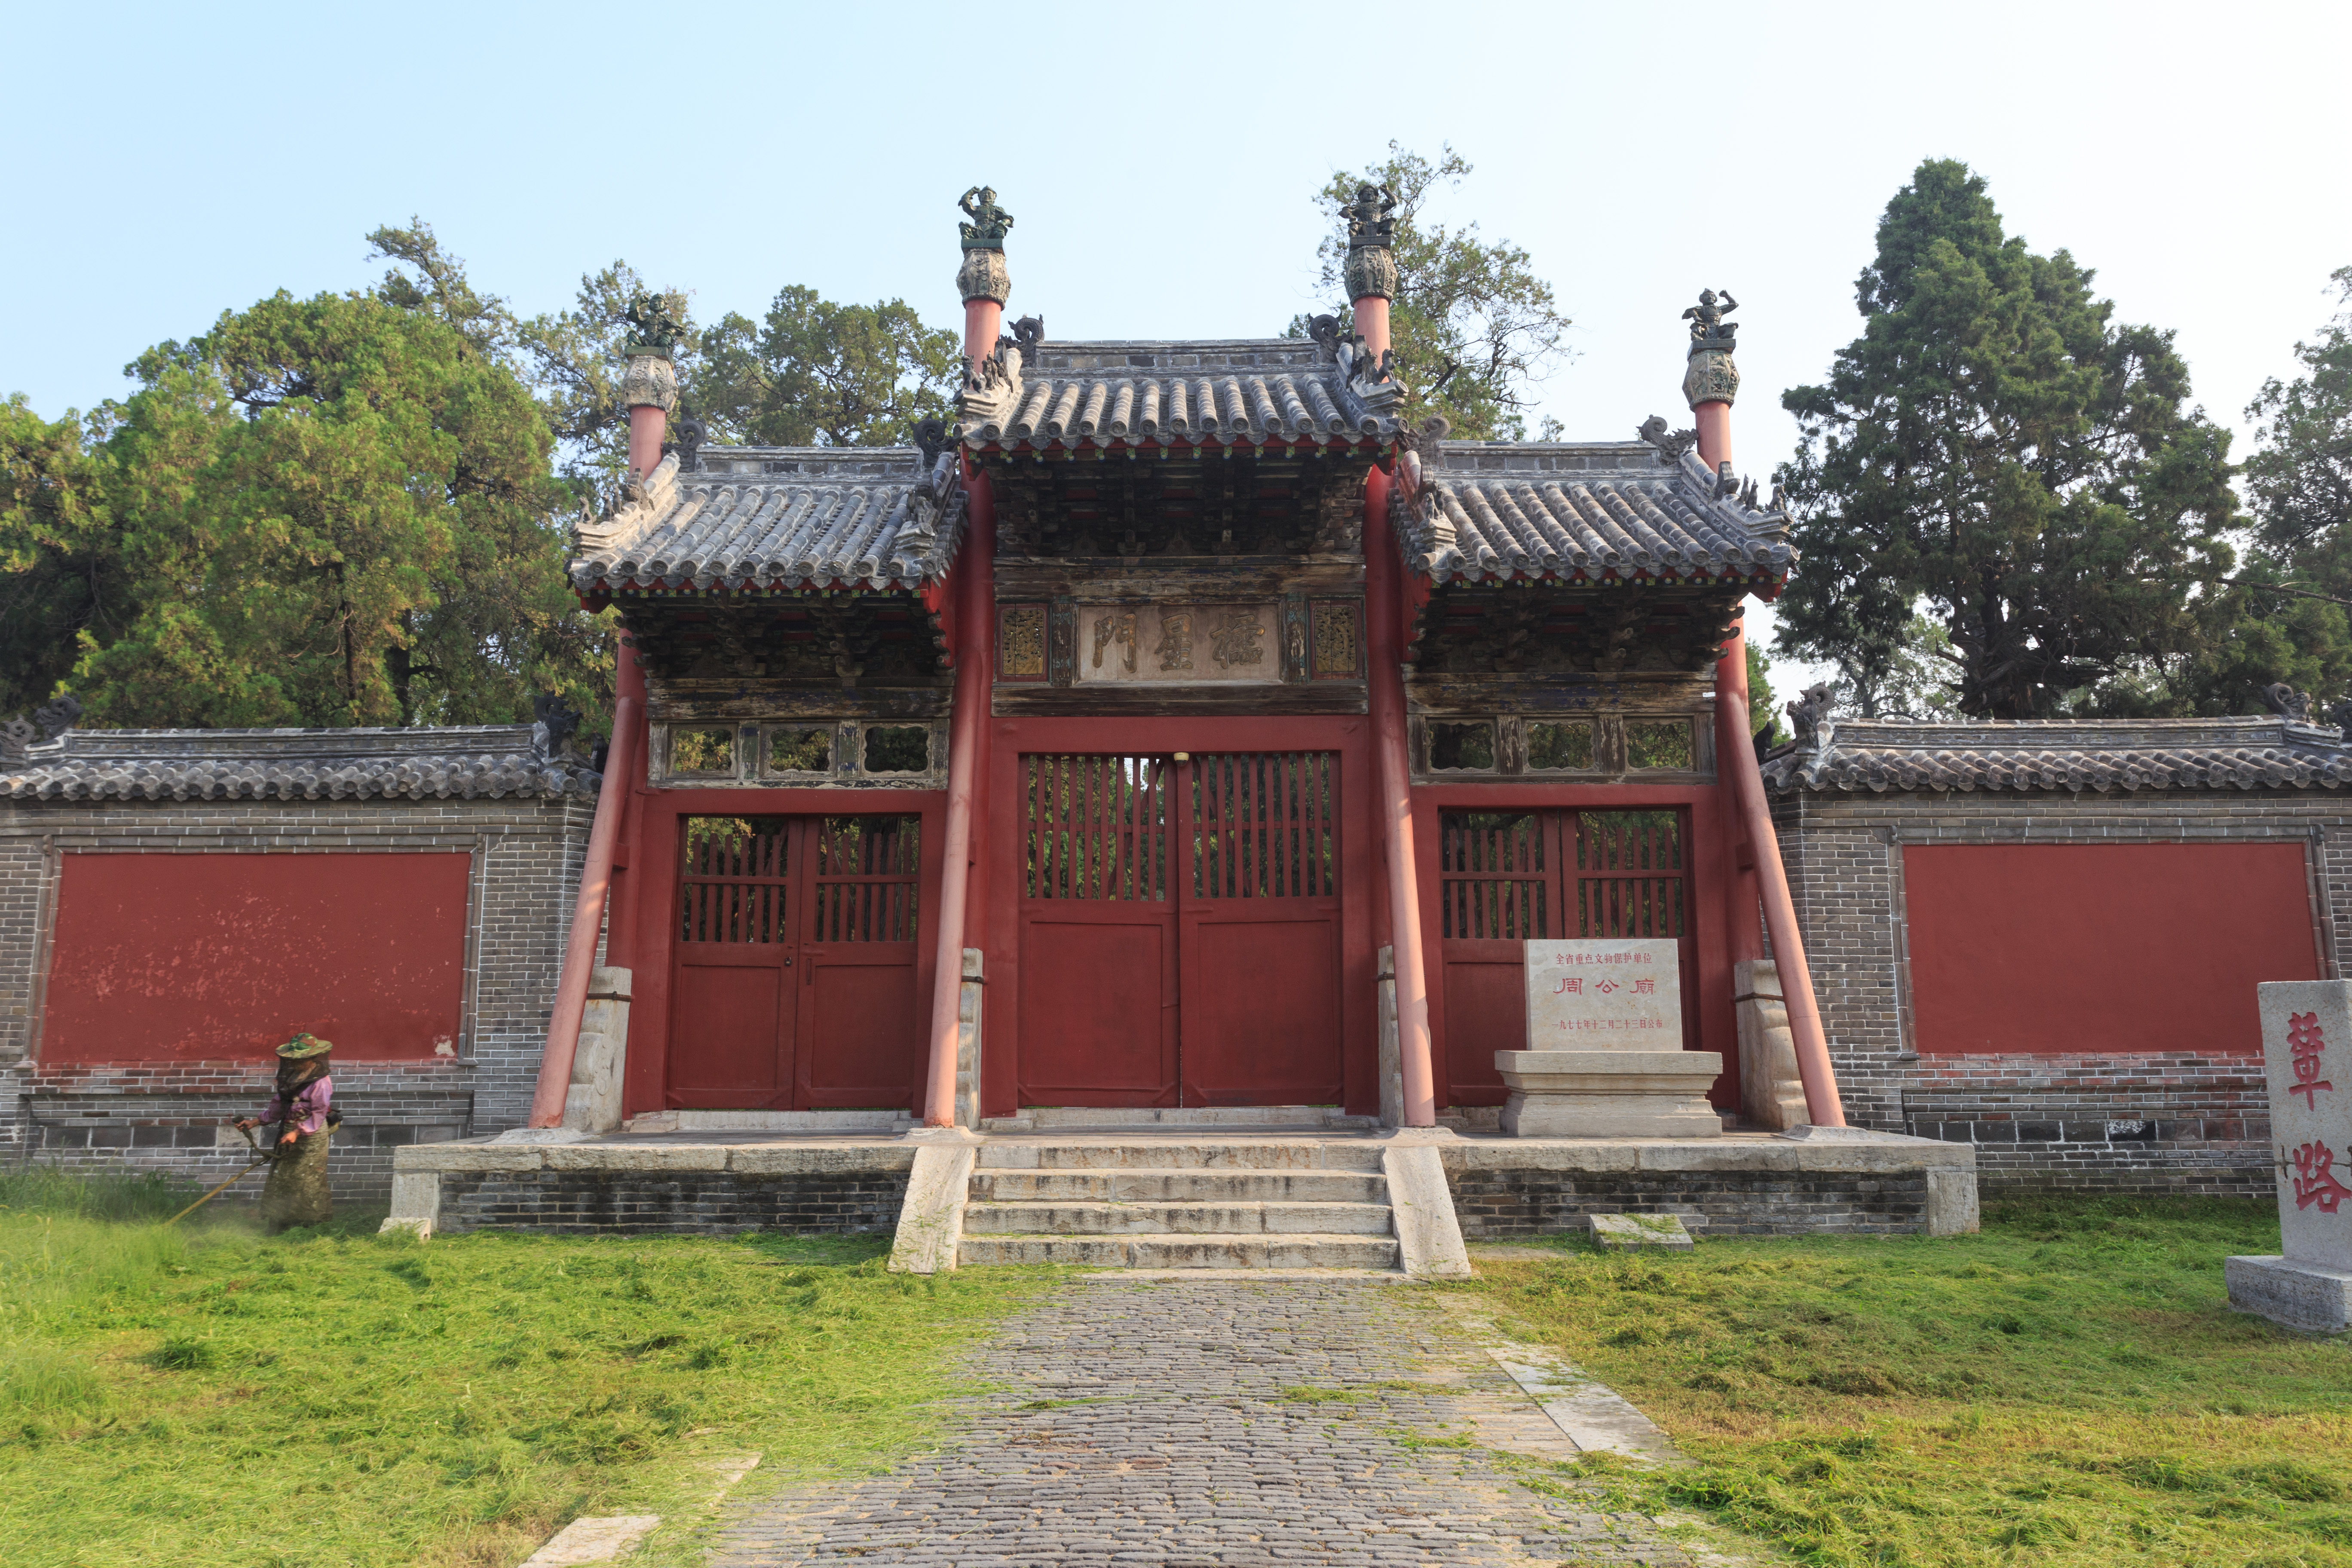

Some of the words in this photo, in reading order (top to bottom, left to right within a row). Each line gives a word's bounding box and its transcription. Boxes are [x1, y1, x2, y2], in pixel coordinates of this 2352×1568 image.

[1556, 953, 1652, 965] 全省重点文物保护单位
[1553, 978, 1655, 995] 周公廟
[1552, 1019, 1663, 1030] 一九七七年十二月二十三日公布
